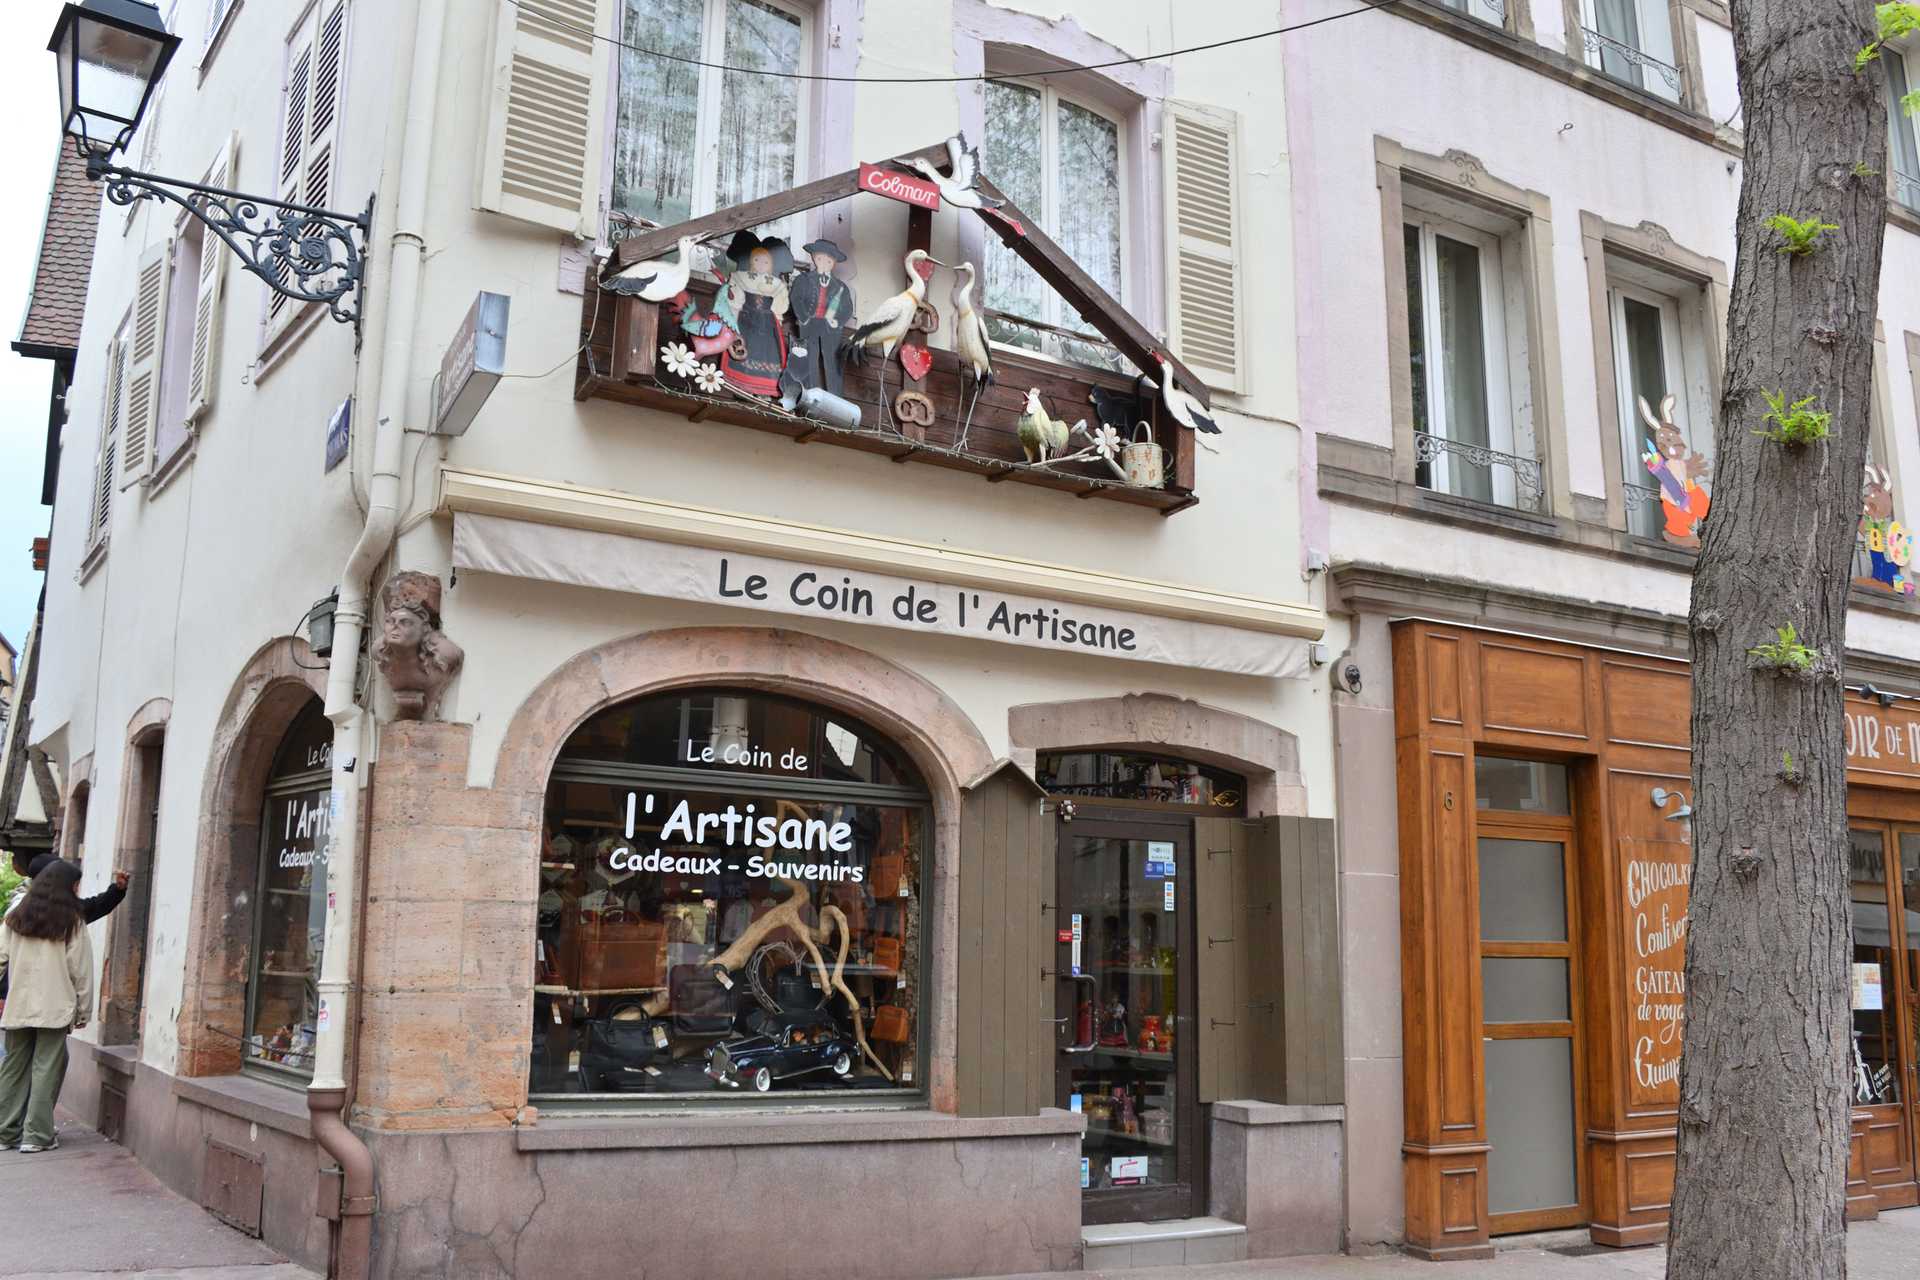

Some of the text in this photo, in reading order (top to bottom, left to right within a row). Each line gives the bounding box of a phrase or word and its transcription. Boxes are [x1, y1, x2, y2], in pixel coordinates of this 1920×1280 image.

[867, 171, 936, 204] Colmar
[719, 559, 768, 600] Le
[790, 572, 873, 616] Coin
[893, 585, 938, 624] de
[306, 745, 319, 767] Le
[687, 739, 808, 771] Le Coin de
[1885, 725, 1905, 756] DE
[1444, 790, 1455, 811] 6
[279, 846, 315, 868] Cadeaux
[609, 847, 722, 876] Cadeaux
[745, 855, 864, 884] Souvenirs
[1638, 991, 1651, 1021] de
